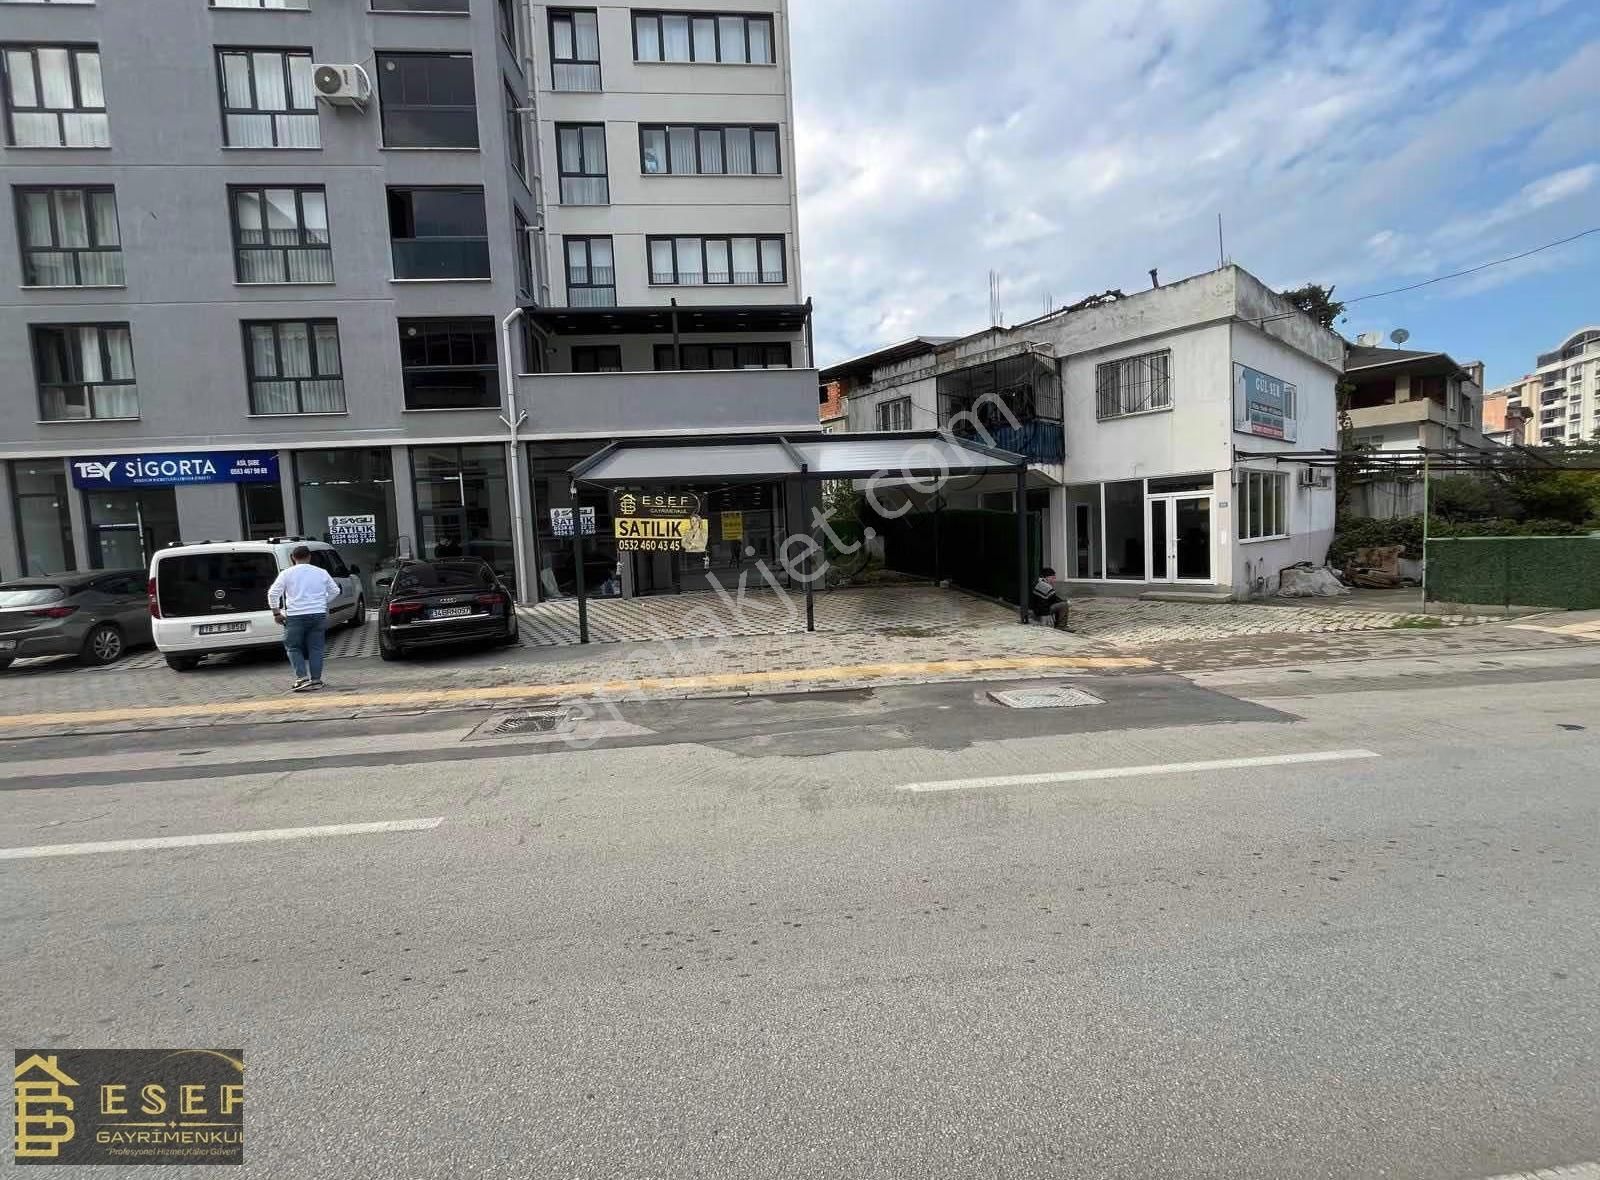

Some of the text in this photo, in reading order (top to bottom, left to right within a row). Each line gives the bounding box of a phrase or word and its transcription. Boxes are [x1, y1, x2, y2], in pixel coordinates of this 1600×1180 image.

[125, 457, 217, 477] SİGORTA
[642, 495, 689, 505] ESEF
[330, 525, 376, 534] SATILIK
[619, 520, 682, 537] SATILIK
[619, 540, 681, 551] 0532 460 43 45
